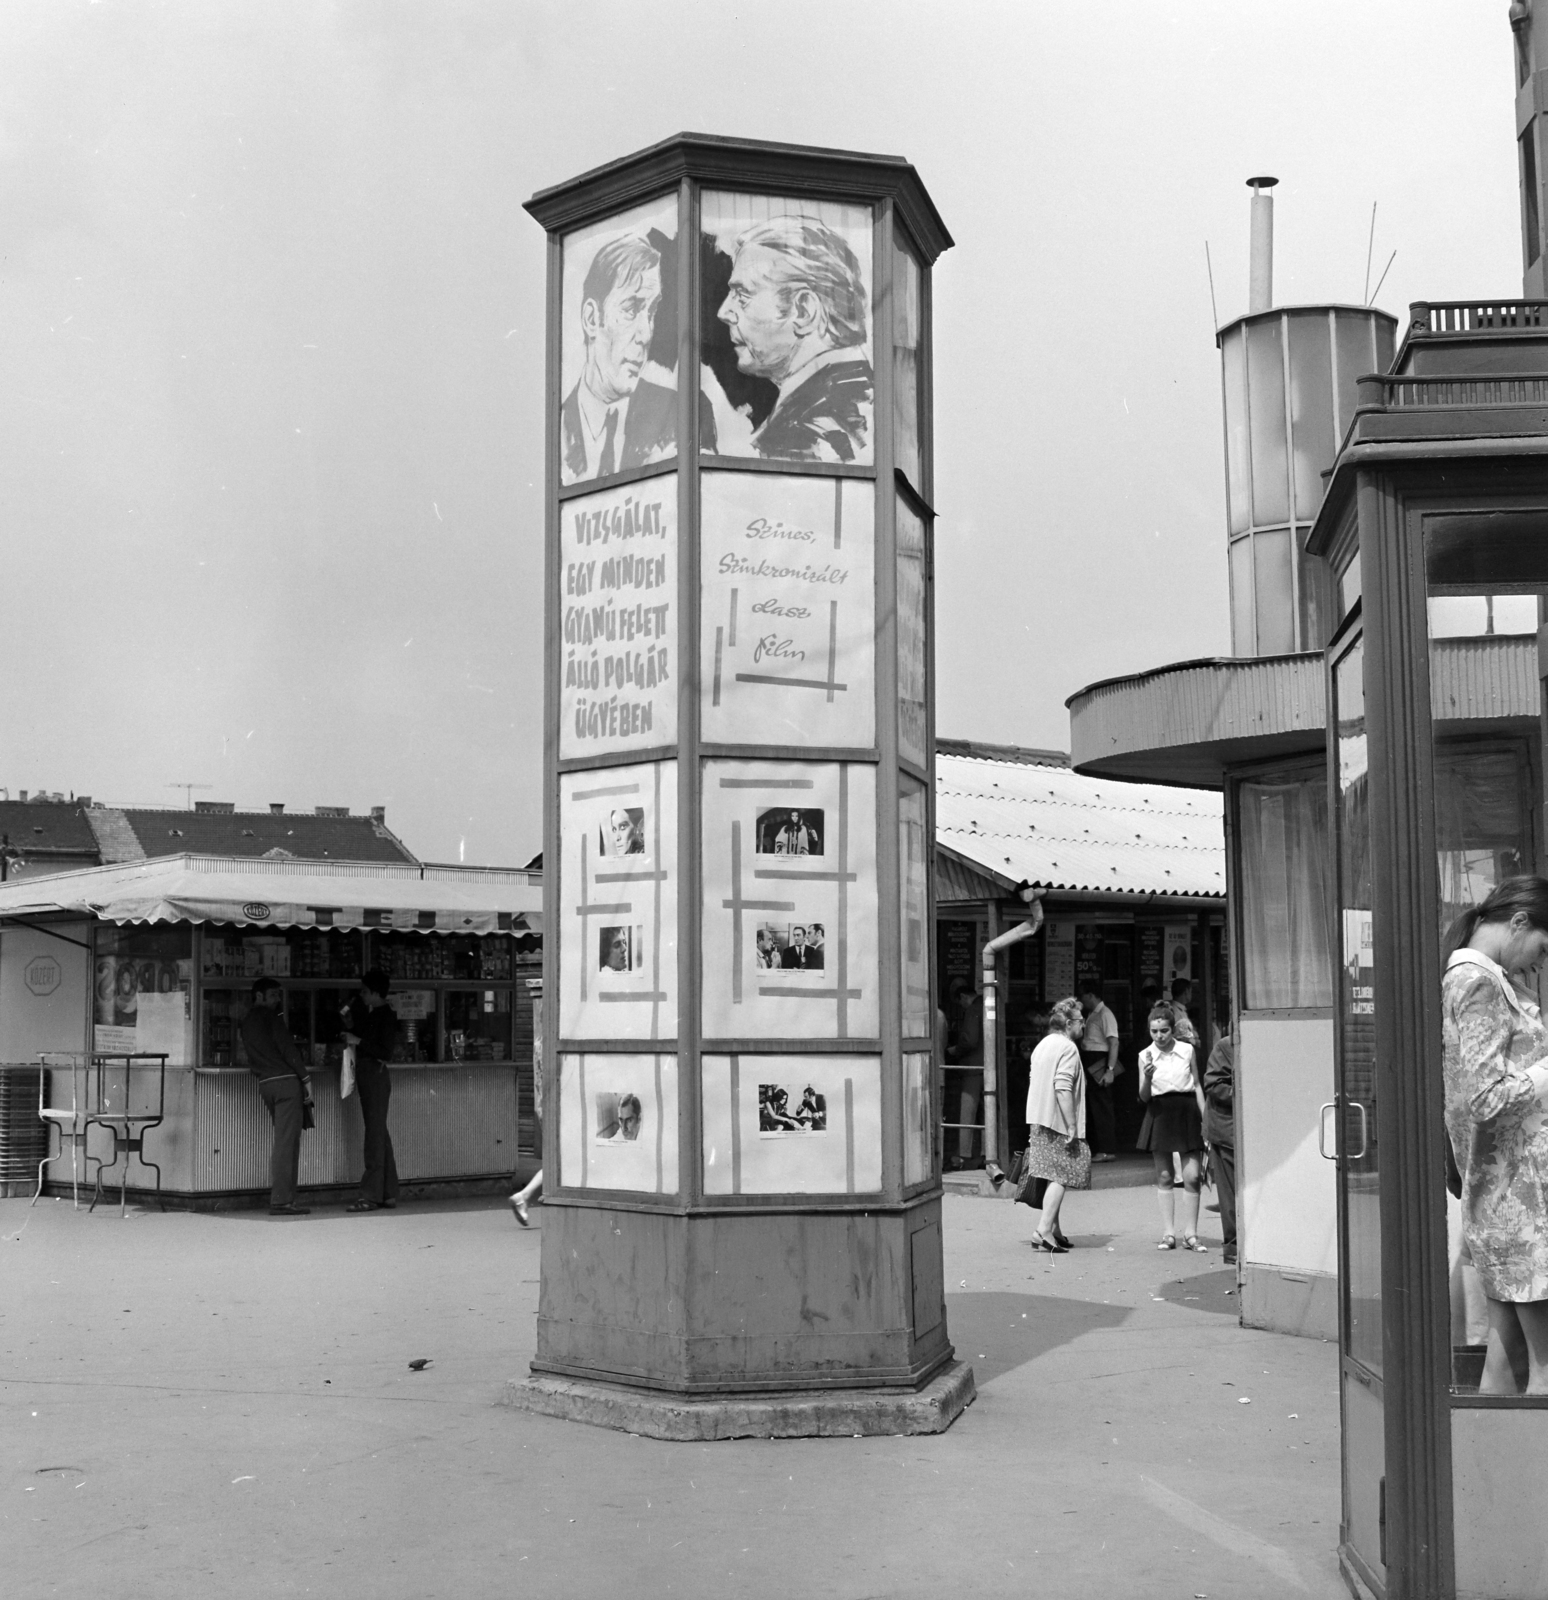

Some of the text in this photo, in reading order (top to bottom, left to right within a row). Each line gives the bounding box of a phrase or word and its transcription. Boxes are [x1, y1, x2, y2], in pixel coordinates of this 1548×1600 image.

[574, 496, 667, 546] VIZSGÁLAT,
[566, 553, 666, 598] EGY MINDEN
[564, 597, 670, 646] GYANÚ FELETT
[751, 598, 812, 619] olasz
[565, 643, 670, 691] ÁLLÓ POLGÁR
[574, 694, 653, 740] ÜGYÉBEN
[306, 906, 436, 929] TEJ
